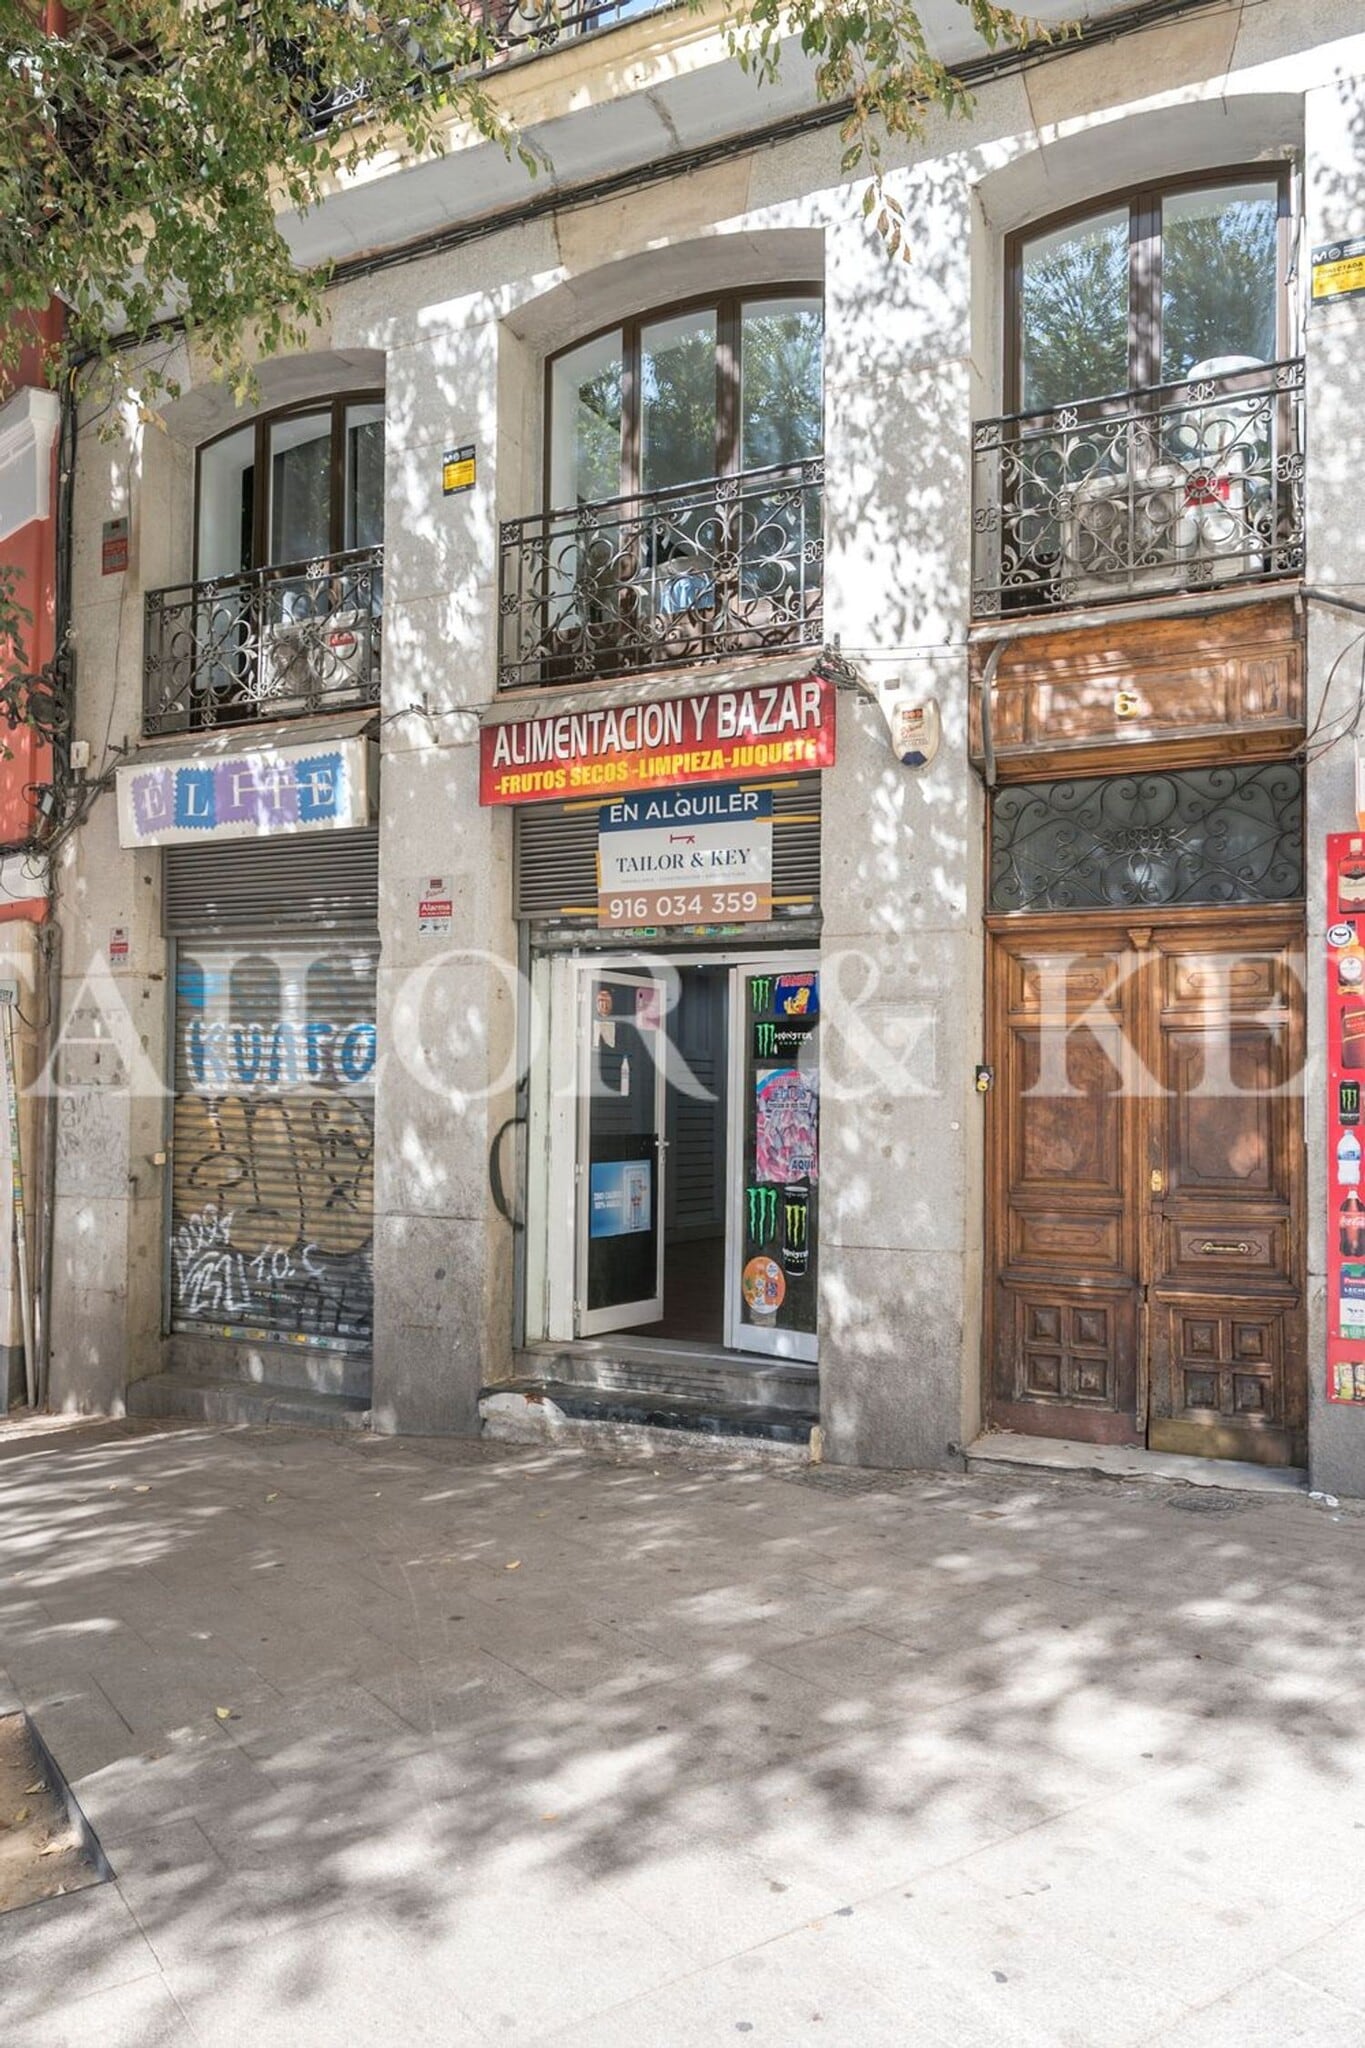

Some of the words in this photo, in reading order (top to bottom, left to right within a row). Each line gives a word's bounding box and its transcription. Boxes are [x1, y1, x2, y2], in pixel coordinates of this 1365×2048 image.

[492, 702, 683, 768] ALIMENTACION
[692, 696, 711, 742] Y
[717, 682, 822, 739] BAZAR
[570, 762, 628, 784] SECOS
[610, 803, 638, 823] EN
[645, 792, 759, 820] ALQUILER
[616, 853, 684, 873] TAILOR
[690, 853, 704, 868] &
[711, 848, 750, 867] KEY
[420, 902, 450, 911] Alarma
[610, 898, 647, 919] 916
[656, 894, 703, 917] 034
[711, 891, 757, 915] 359
